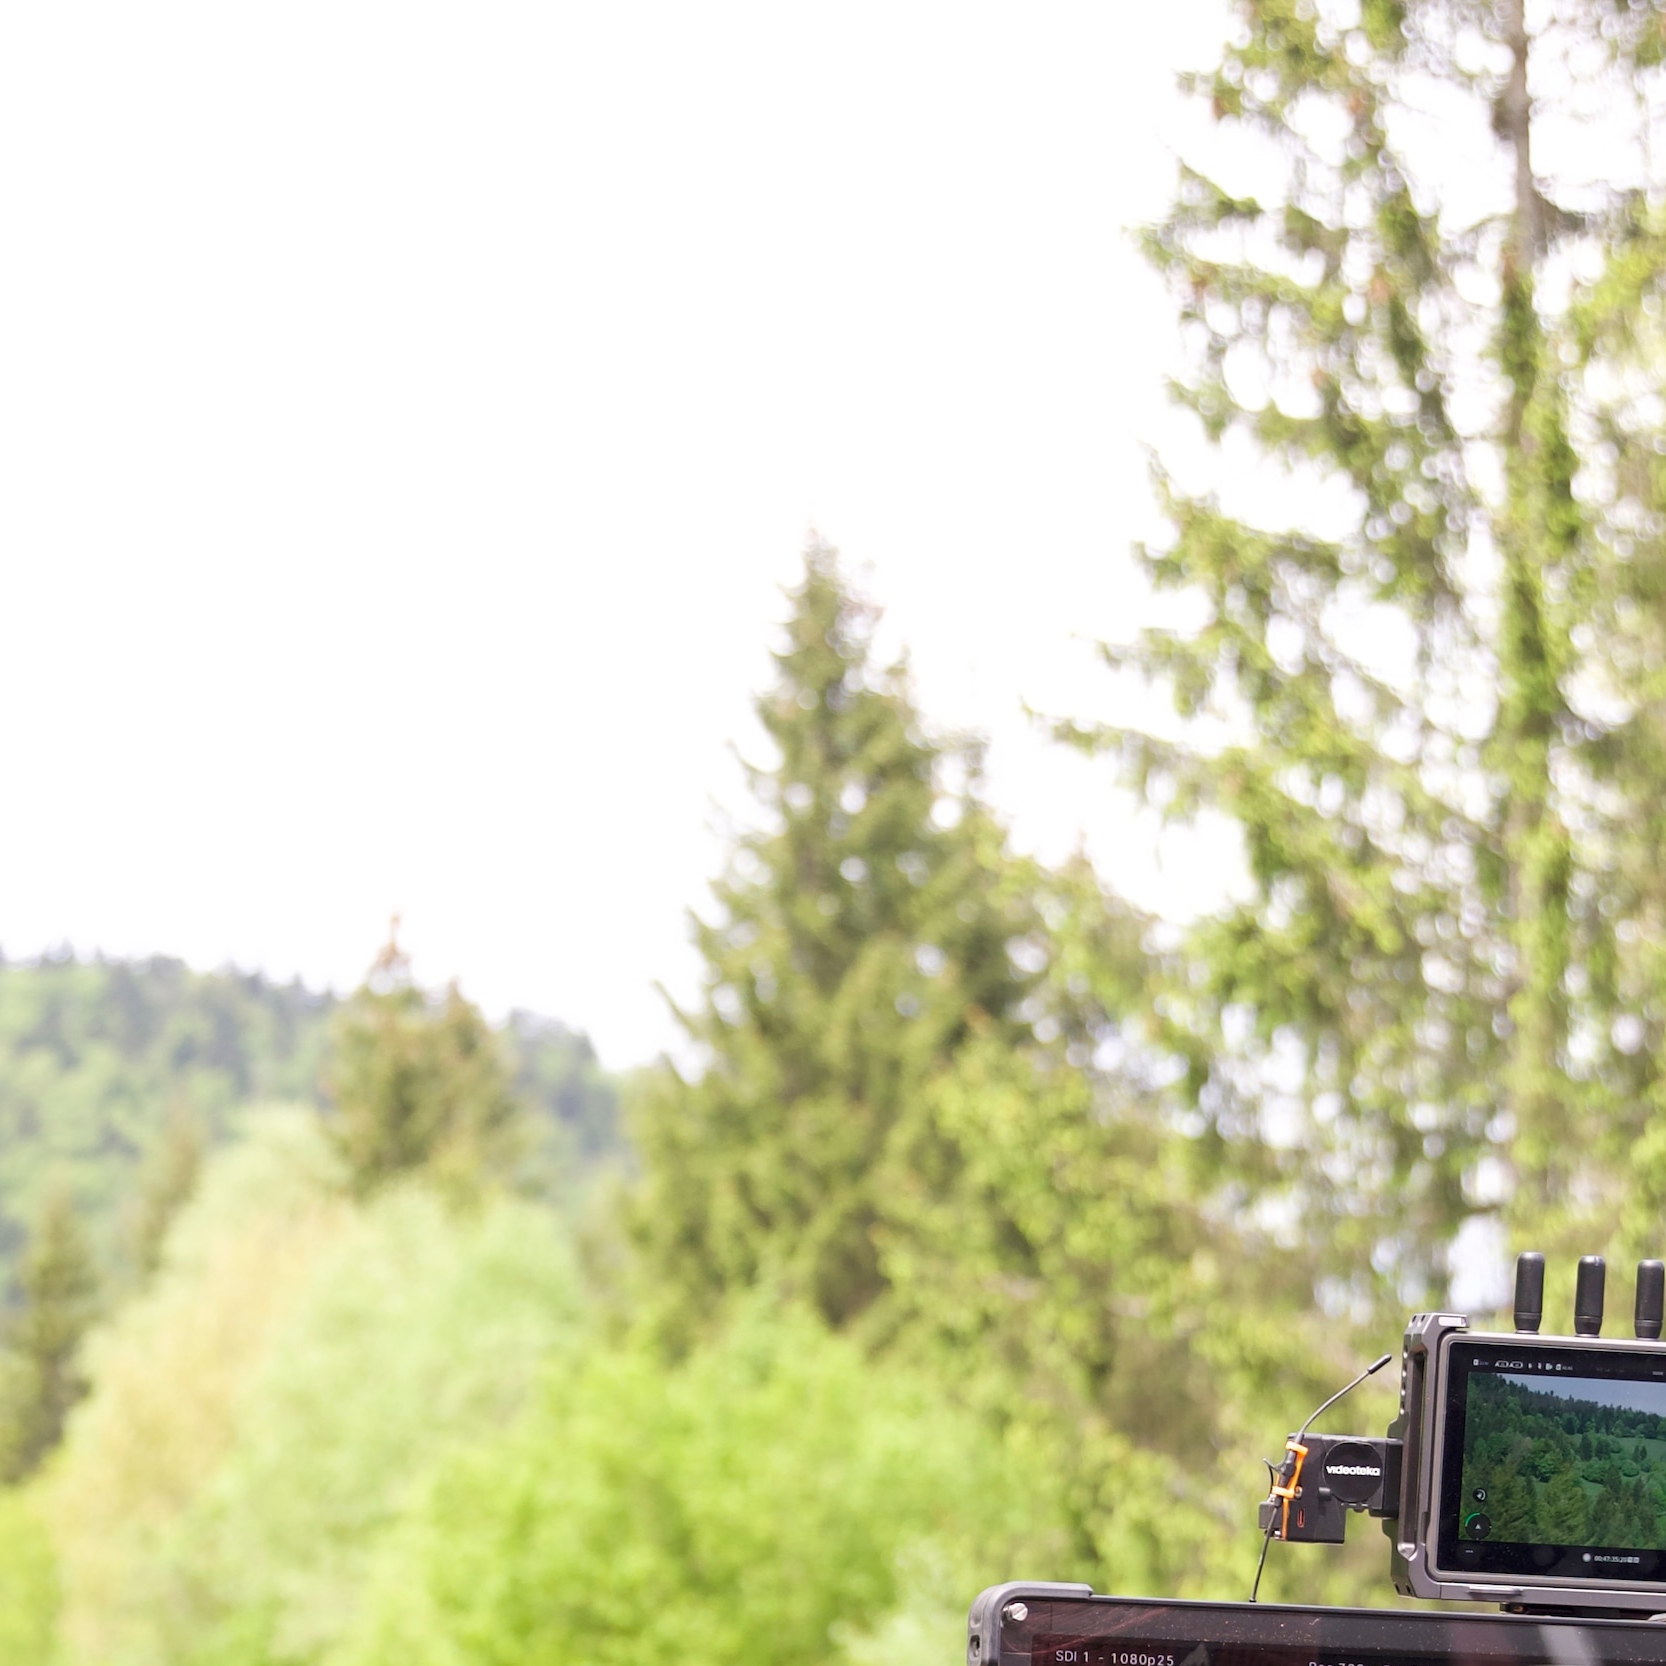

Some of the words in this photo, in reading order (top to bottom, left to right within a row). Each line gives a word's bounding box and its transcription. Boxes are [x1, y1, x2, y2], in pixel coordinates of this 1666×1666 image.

[1326, 1465, 1380, 1476] videoteka
[1055, 1650, 1077, 1662] SDI
[1083, 1651, 1089, 1662] 1
[1111, 1652, 1174, 1666] 1080p25
